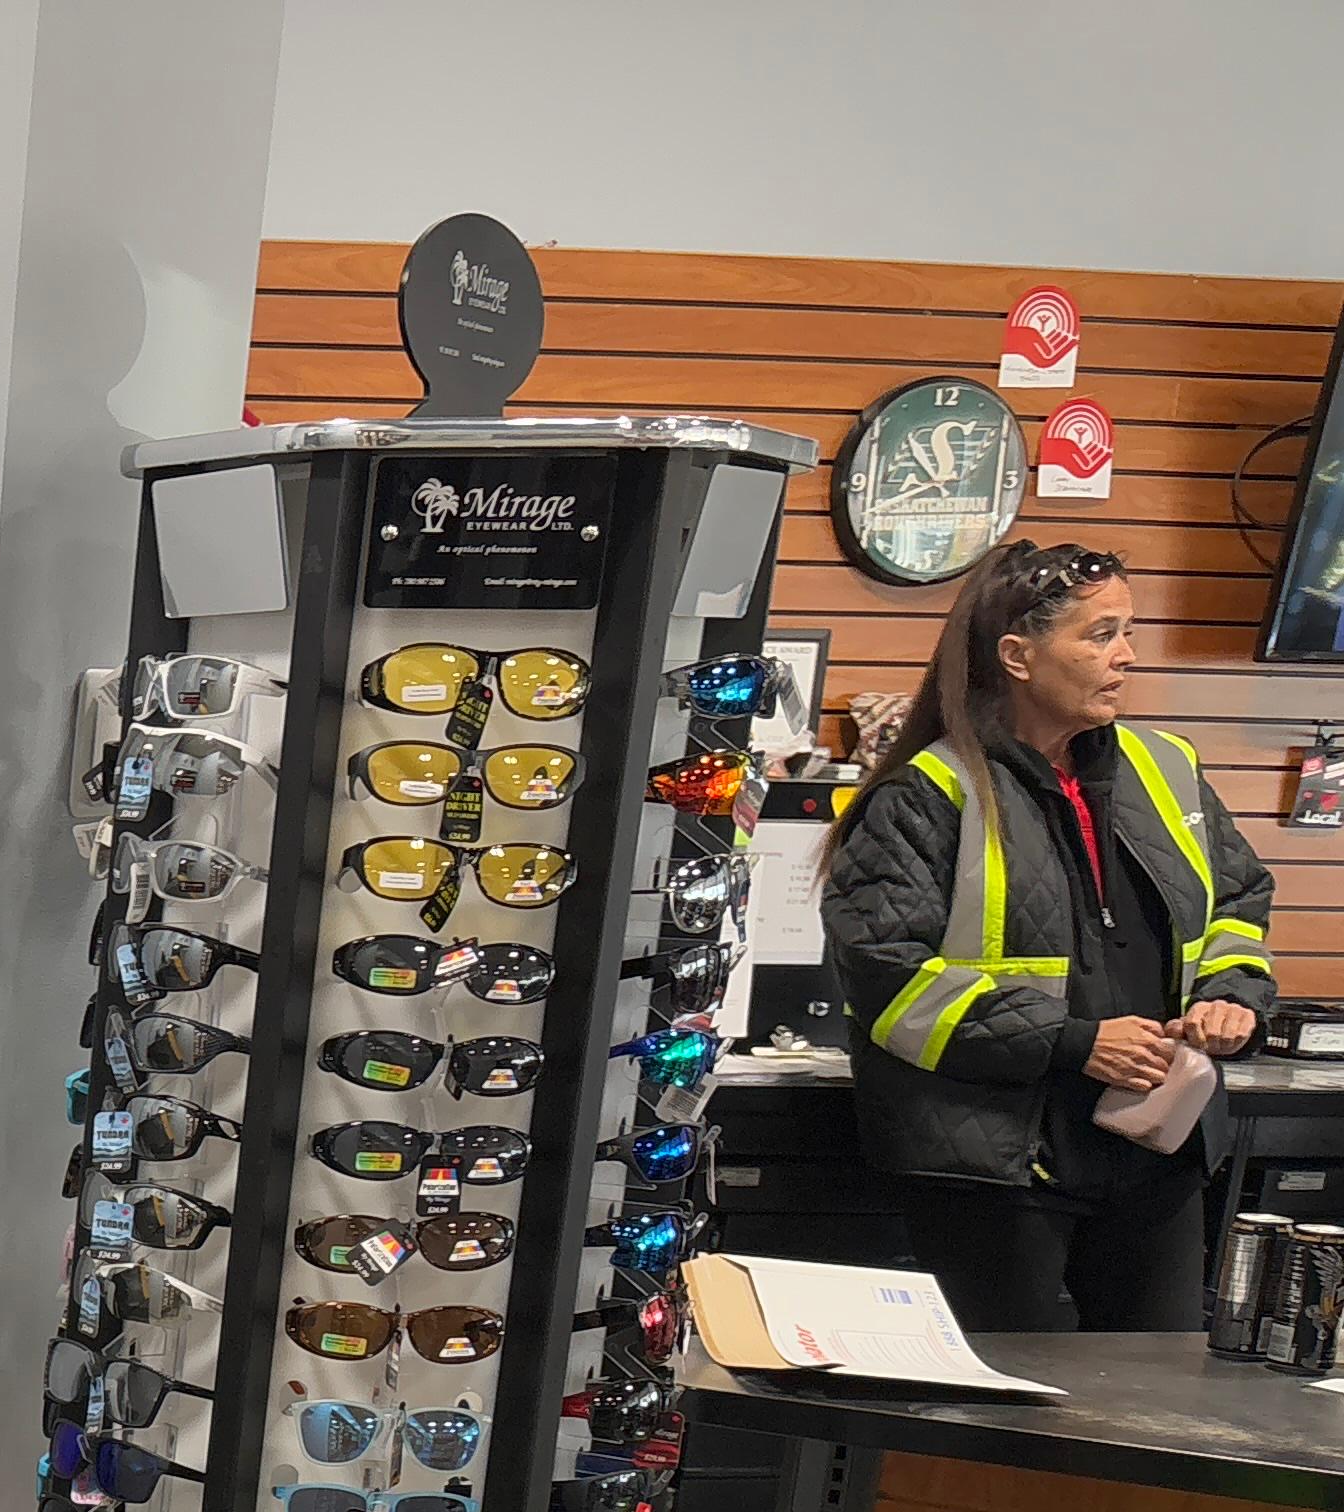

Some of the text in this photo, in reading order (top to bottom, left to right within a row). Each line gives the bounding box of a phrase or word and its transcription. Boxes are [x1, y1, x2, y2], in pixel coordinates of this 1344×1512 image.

[934, 387, 960, 407] 12
[850, 472, 865, 492] 9
[1003, 471, 1019, 489] 3
[460, 483, 577, 531] Mirage
[466, 522, 574, 531] EYEWEAR LTD.
